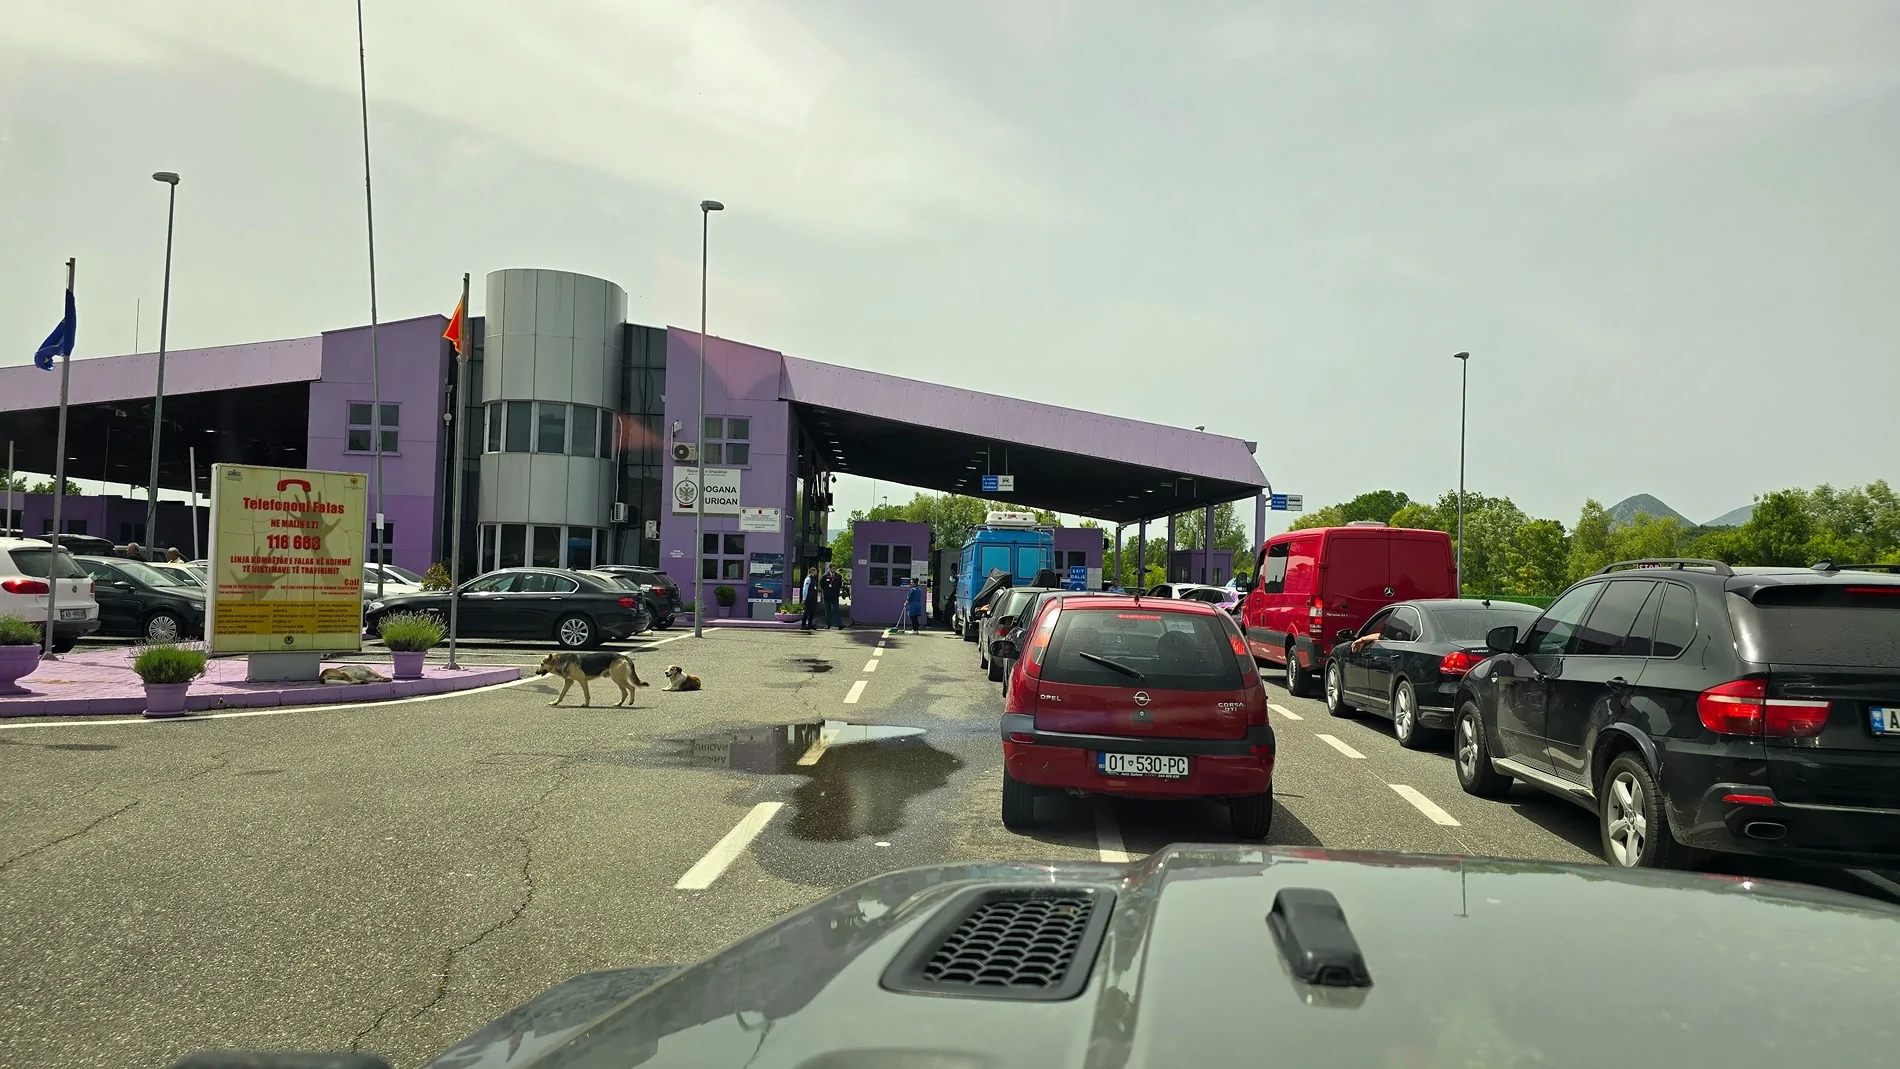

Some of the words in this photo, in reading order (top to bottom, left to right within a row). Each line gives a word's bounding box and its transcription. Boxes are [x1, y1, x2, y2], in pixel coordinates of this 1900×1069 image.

[704, 485, 737, 494] OGANA
[243, 497, 310, 513] Telefononi
[313, 502, 345, 514] Falas
[704, 497, 738, 506] URIQAN
[230, 555, 250, 564] LINJA
[294, 557, 314, 566] FALAS
[301, 566, 340, 575] TRAFIKIMIT
[344, 578, 360, 586] Call
[1040, 694, 1062, 702] OPEL
